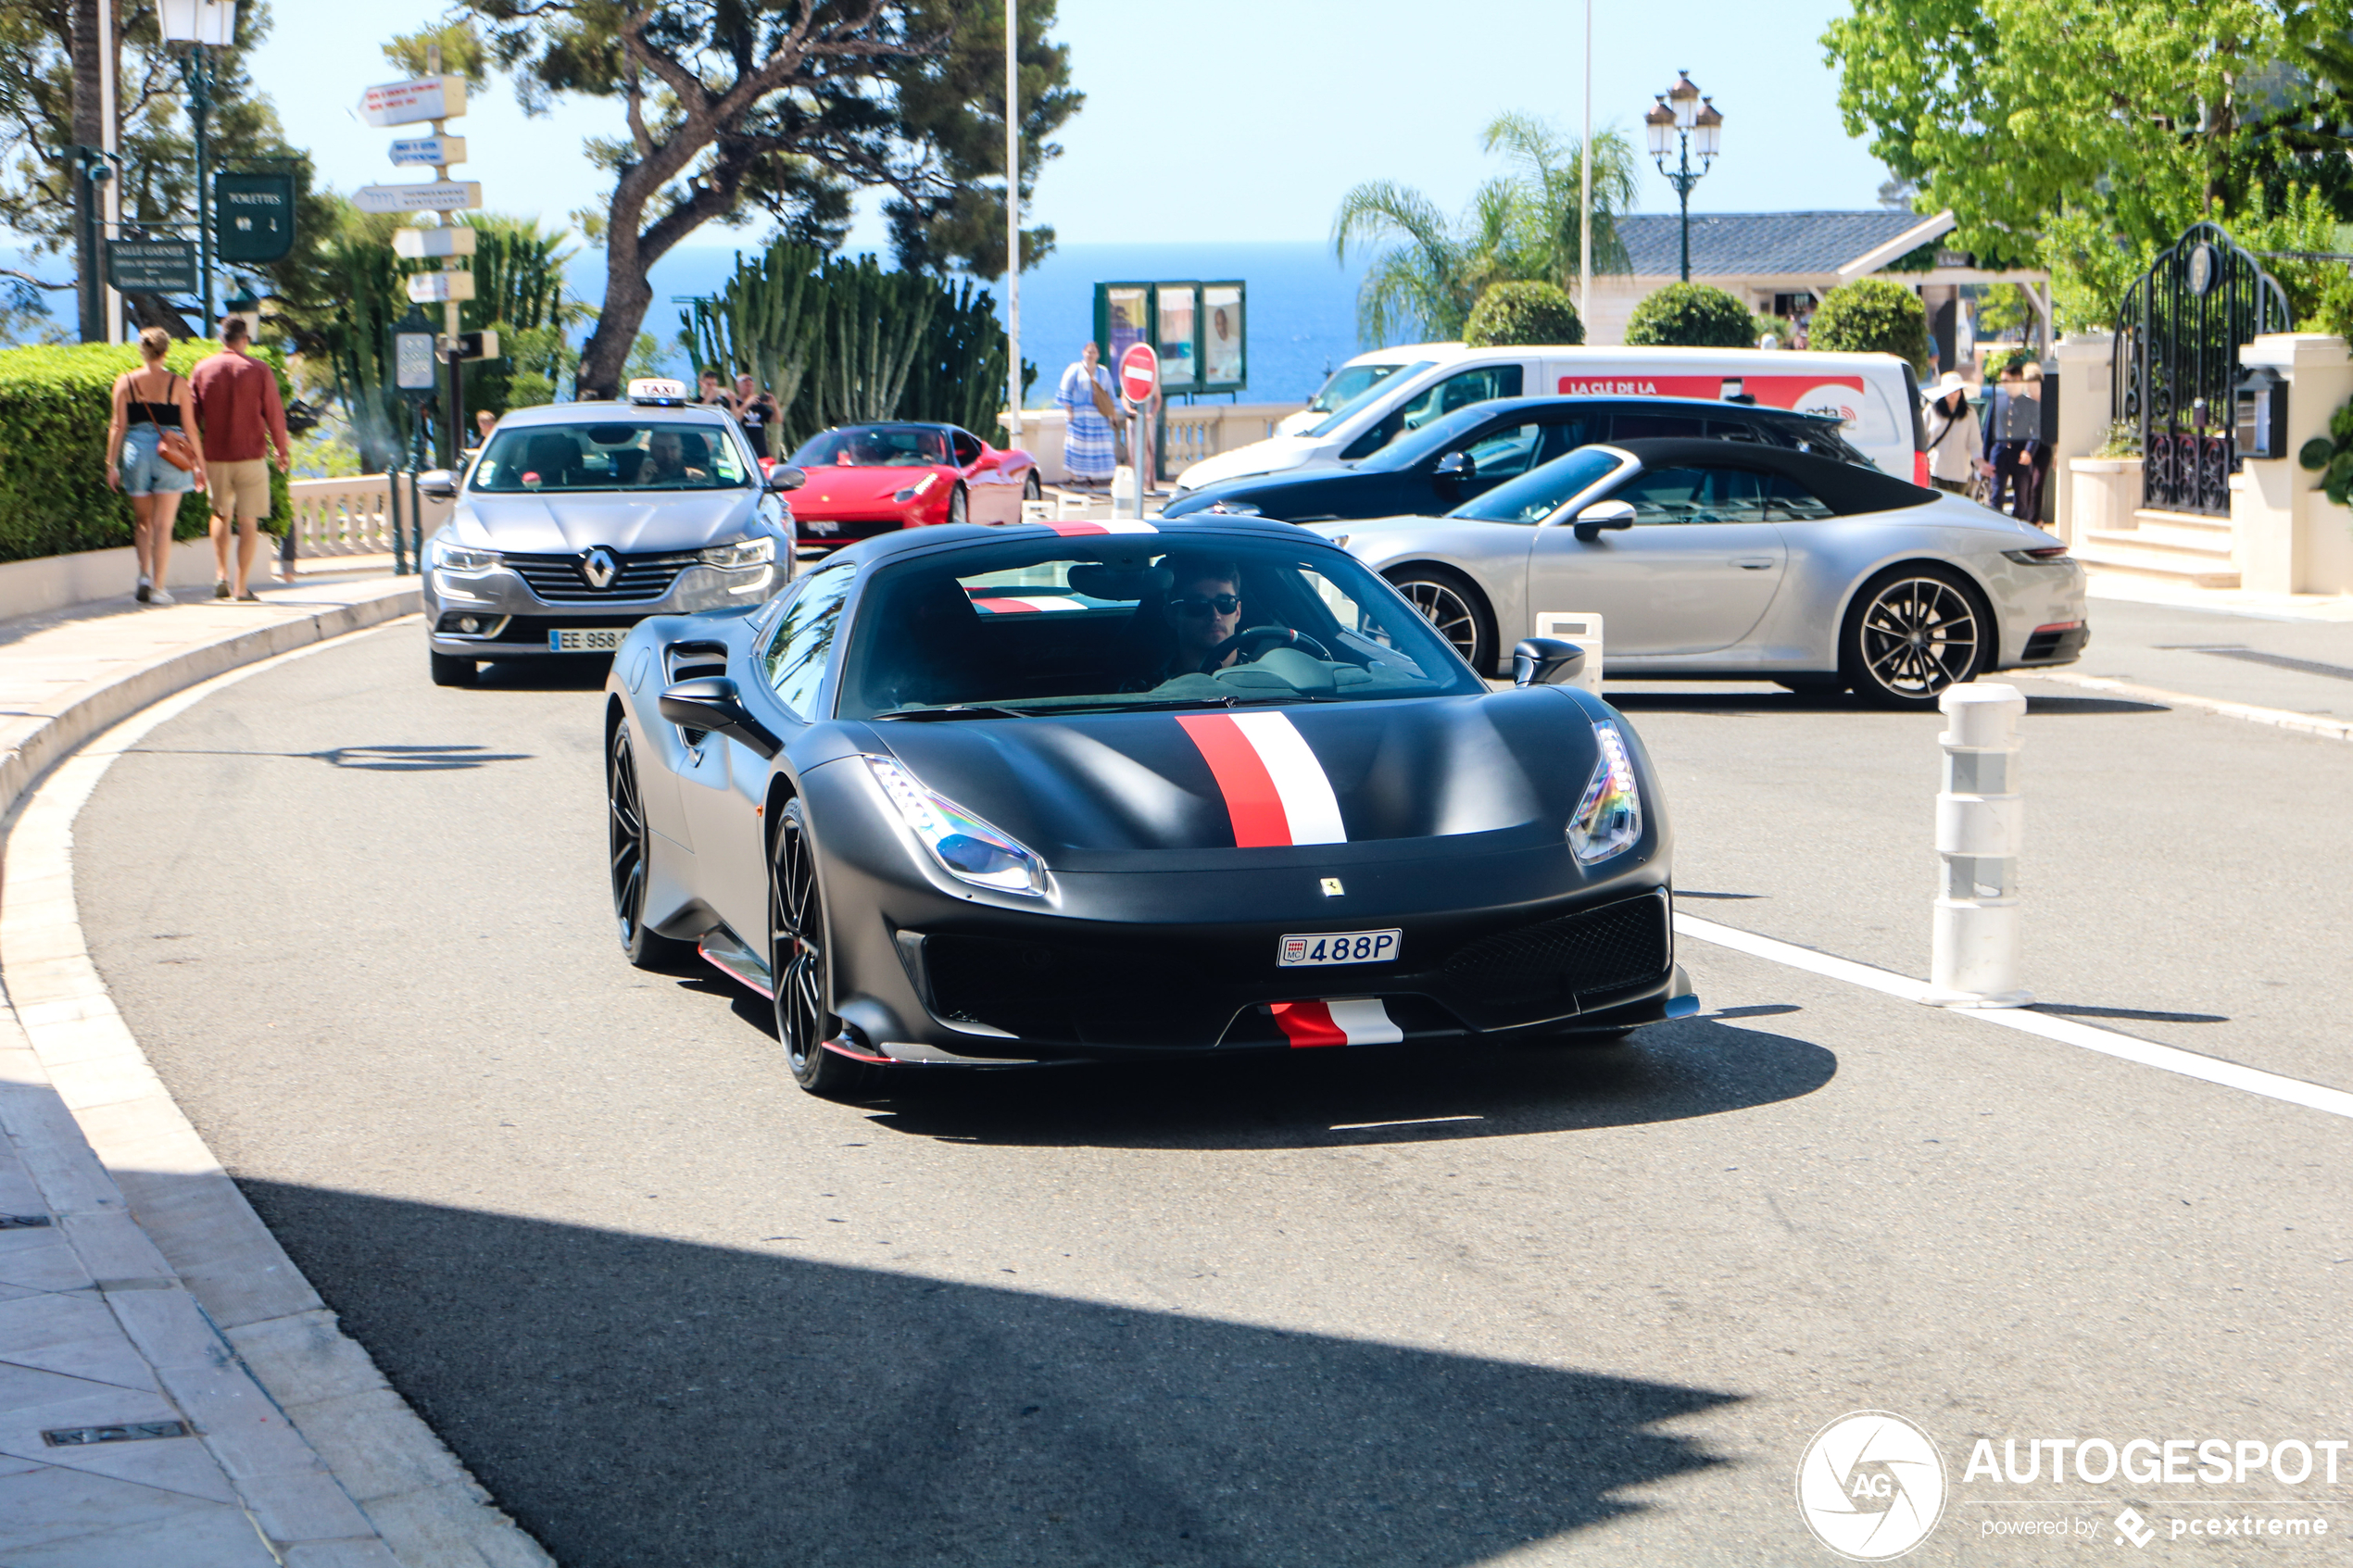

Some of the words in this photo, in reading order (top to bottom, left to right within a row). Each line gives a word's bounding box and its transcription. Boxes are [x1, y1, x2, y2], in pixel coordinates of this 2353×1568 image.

[642, 384, 676, 395] TAXI
[1570, 382, 1590, 395] LA
[1591, 380, 1614, 395] CLÉ
[1617, 382, 1635, 395] DE
[1638, 382, 1657, 395] LA
[1310, 935, 1392, 961] 488P
[1287, 951, 1302, 960] MC
